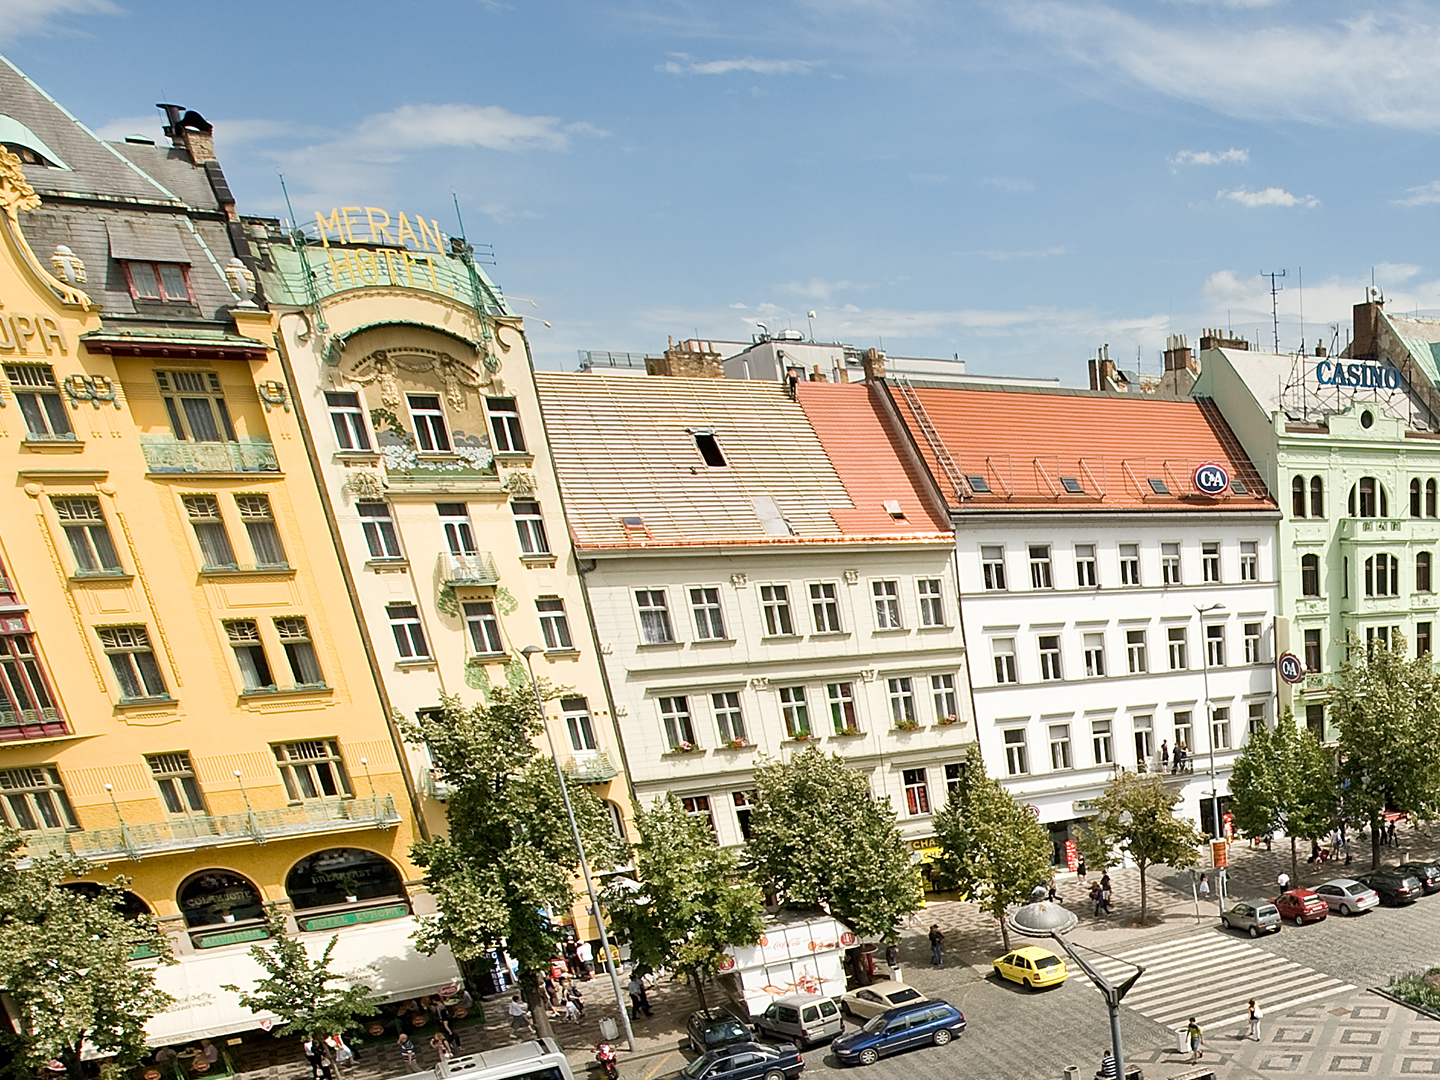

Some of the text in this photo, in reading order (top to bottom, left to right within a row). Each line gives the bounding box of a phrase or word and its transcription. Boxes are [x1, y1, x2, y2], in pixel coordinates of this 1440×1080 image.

[314, 206, 447, 256] MERAN
[328, 247, 454, 296] HOTEL
[1316, 360, 1400, 390] CASINO
[1201, 471, 1224, 487] C&A
